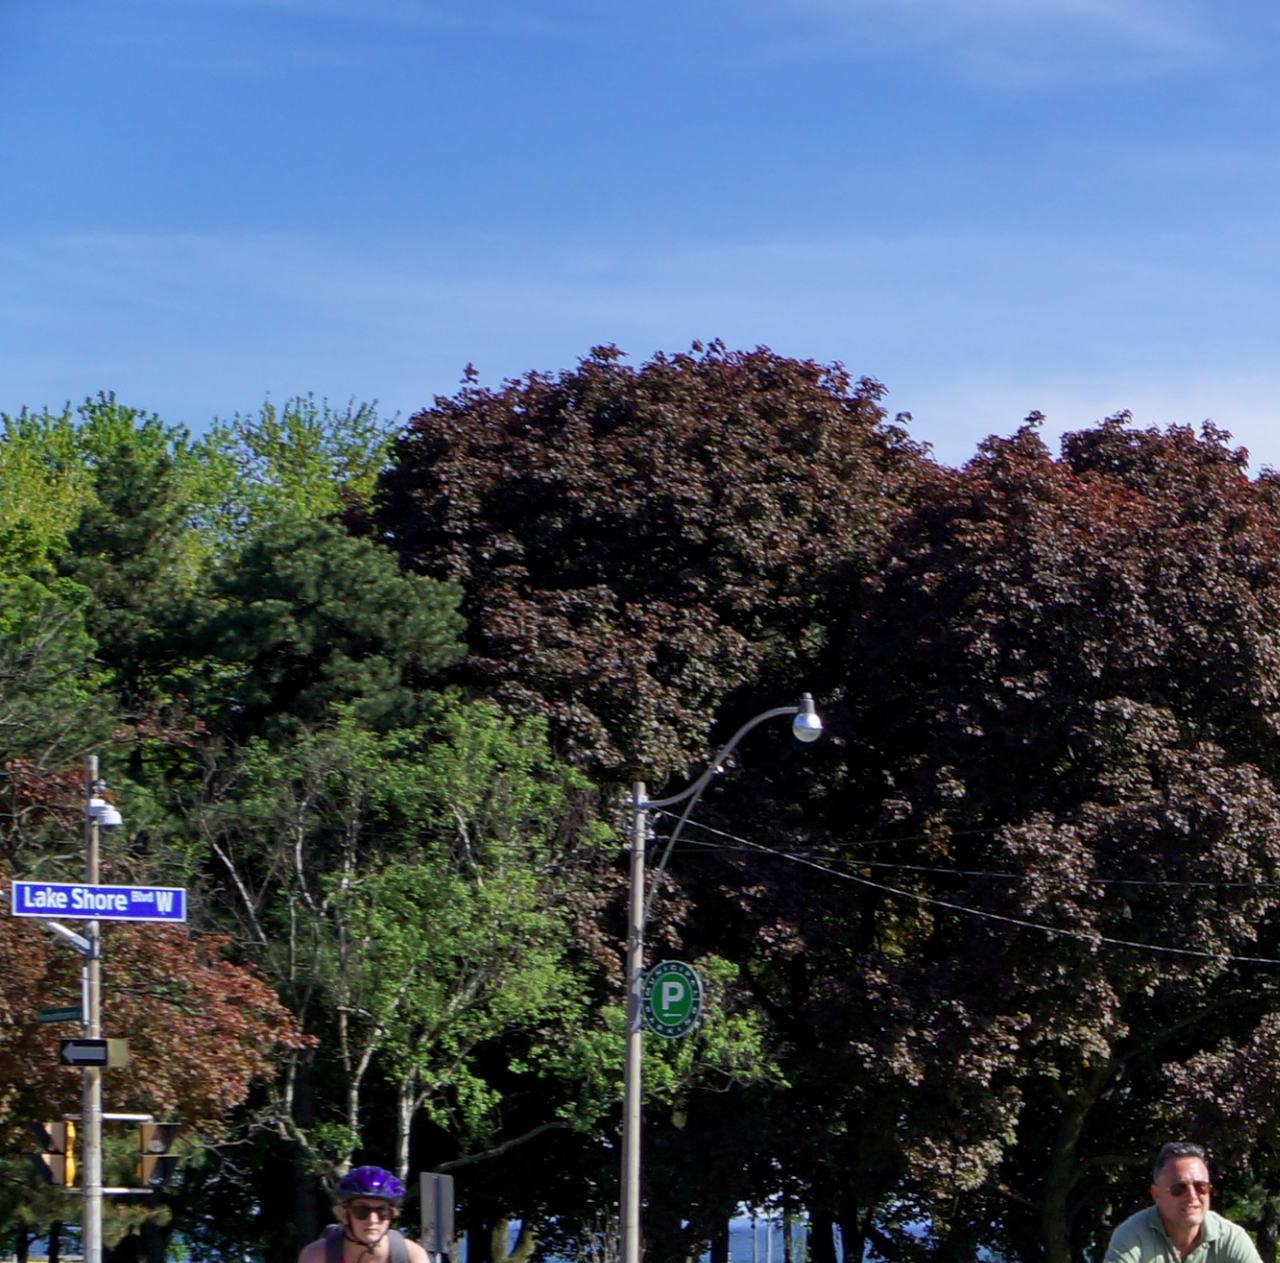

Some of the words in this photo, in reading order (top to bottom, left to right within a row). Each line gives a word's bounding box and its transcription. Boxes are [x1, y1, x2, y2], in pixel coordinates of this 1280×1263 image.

[24, 886, 68, 909] Lake
[71, 887, 128, 911] Shore
[131, 890, 154, 903] Blvd
[156, 891, 174, 912] W
[662, 981, 685, 1010] P
